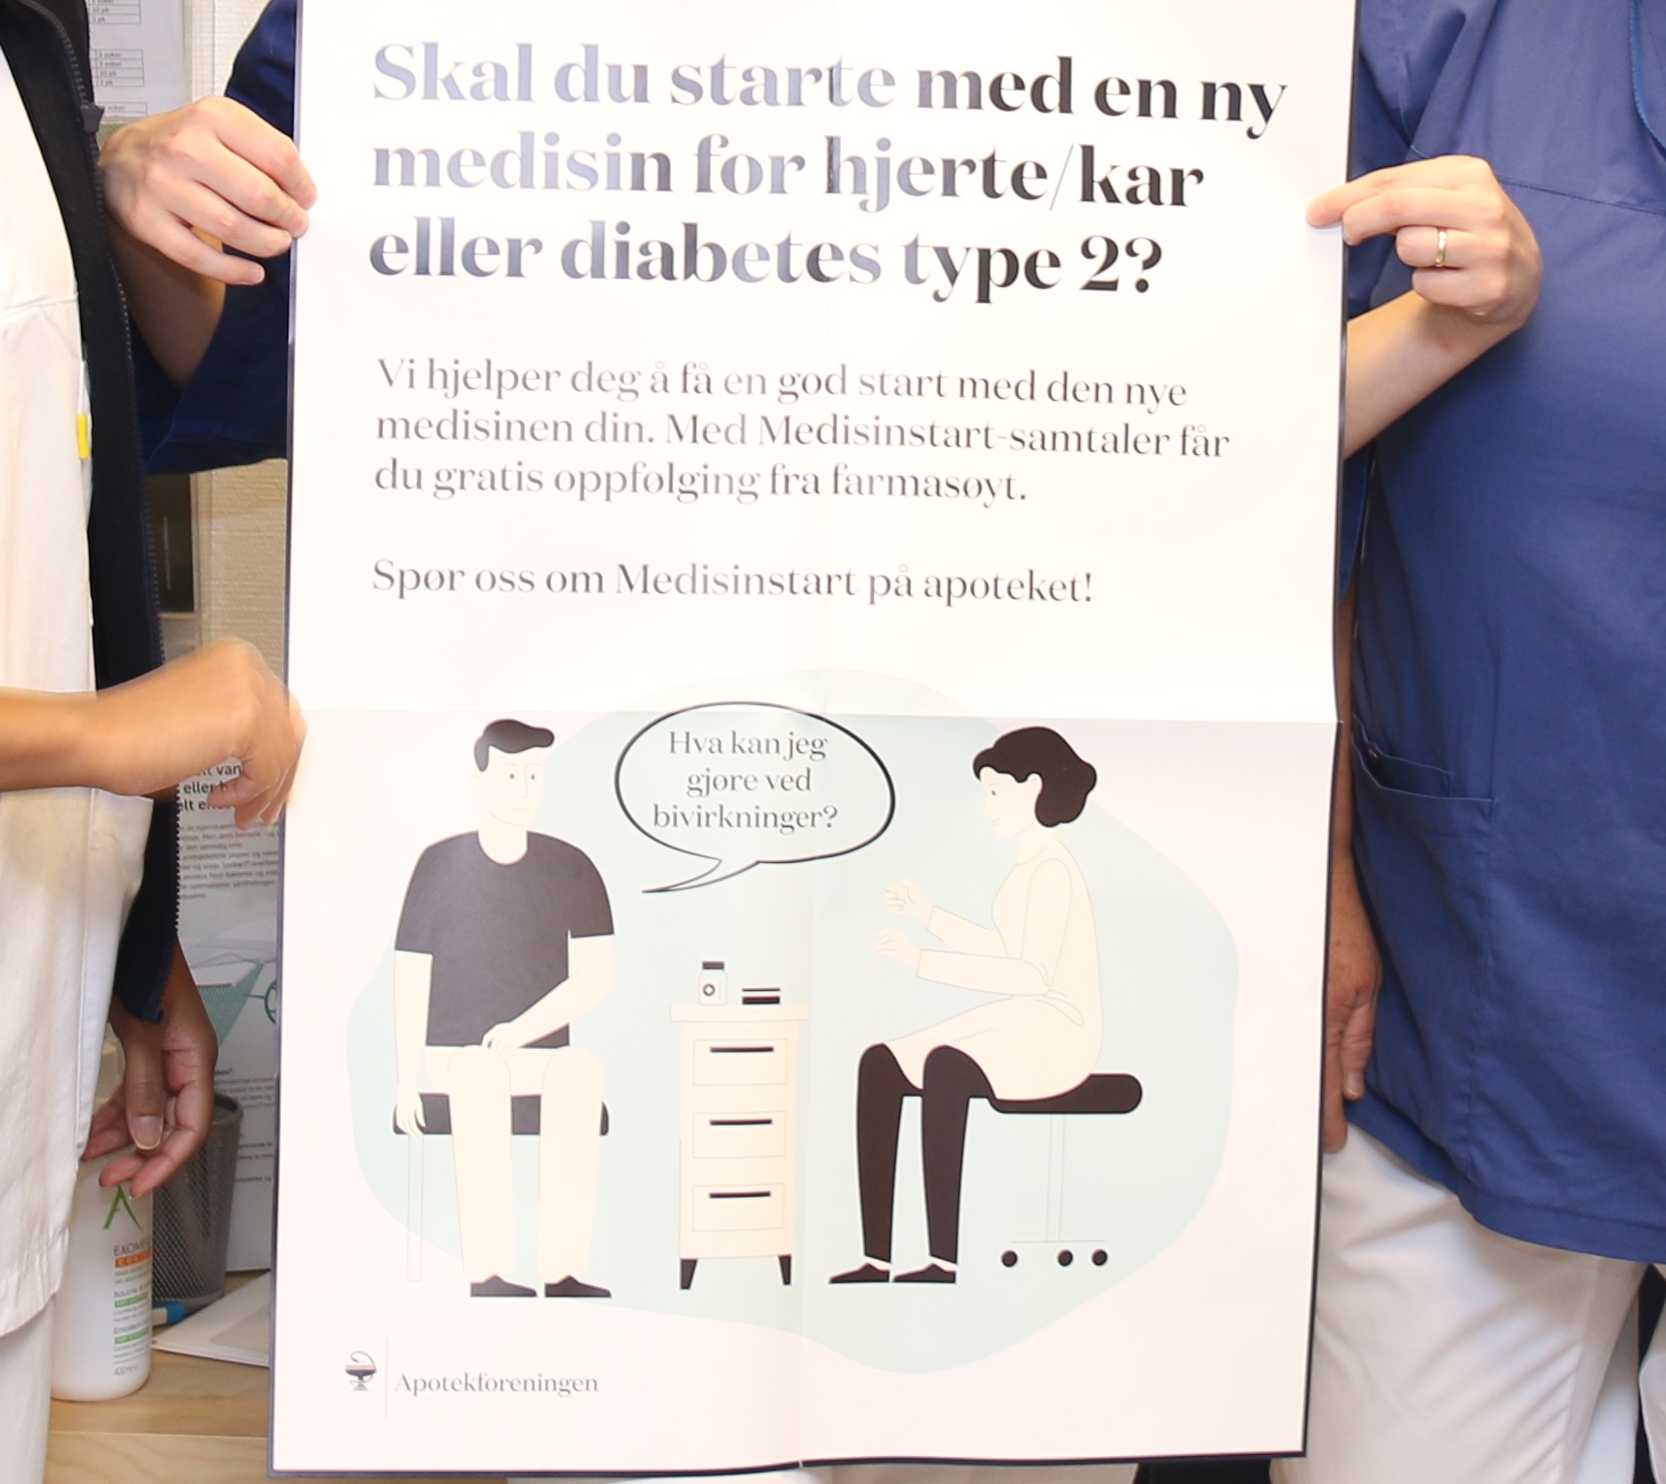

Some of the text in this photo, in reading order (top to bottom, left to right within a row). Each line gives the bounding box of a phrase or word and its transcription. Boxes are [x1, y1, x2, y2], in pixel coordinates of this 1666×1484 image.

[375, 43, 1287, 140] Skal du starte med en ny
[375, 133, 1204, 212] medisin for hjerte/kar
[370, 218, 1162, 304] eller diabetes type 2?
[378, 357, 1186, 411] Vi hjelper deg å få en god start med den nye
[376, 410, 1229, 459] medisinen din. Med Medisinstart-samtaler får
[375, 461, 1026, 507] du gratis oppfølging fra farmasøyt.
[373, 560, 1092, 607] Spør oss om Medisinstart på apoteket!
[668, 731, 827, 764] Hva kan jeg
[686, 768, 811, 798] gjøre ved
[652, 802, 837, 835] bivirkninger?
[395, 1369, 599, 1397] Apotekforeningen
